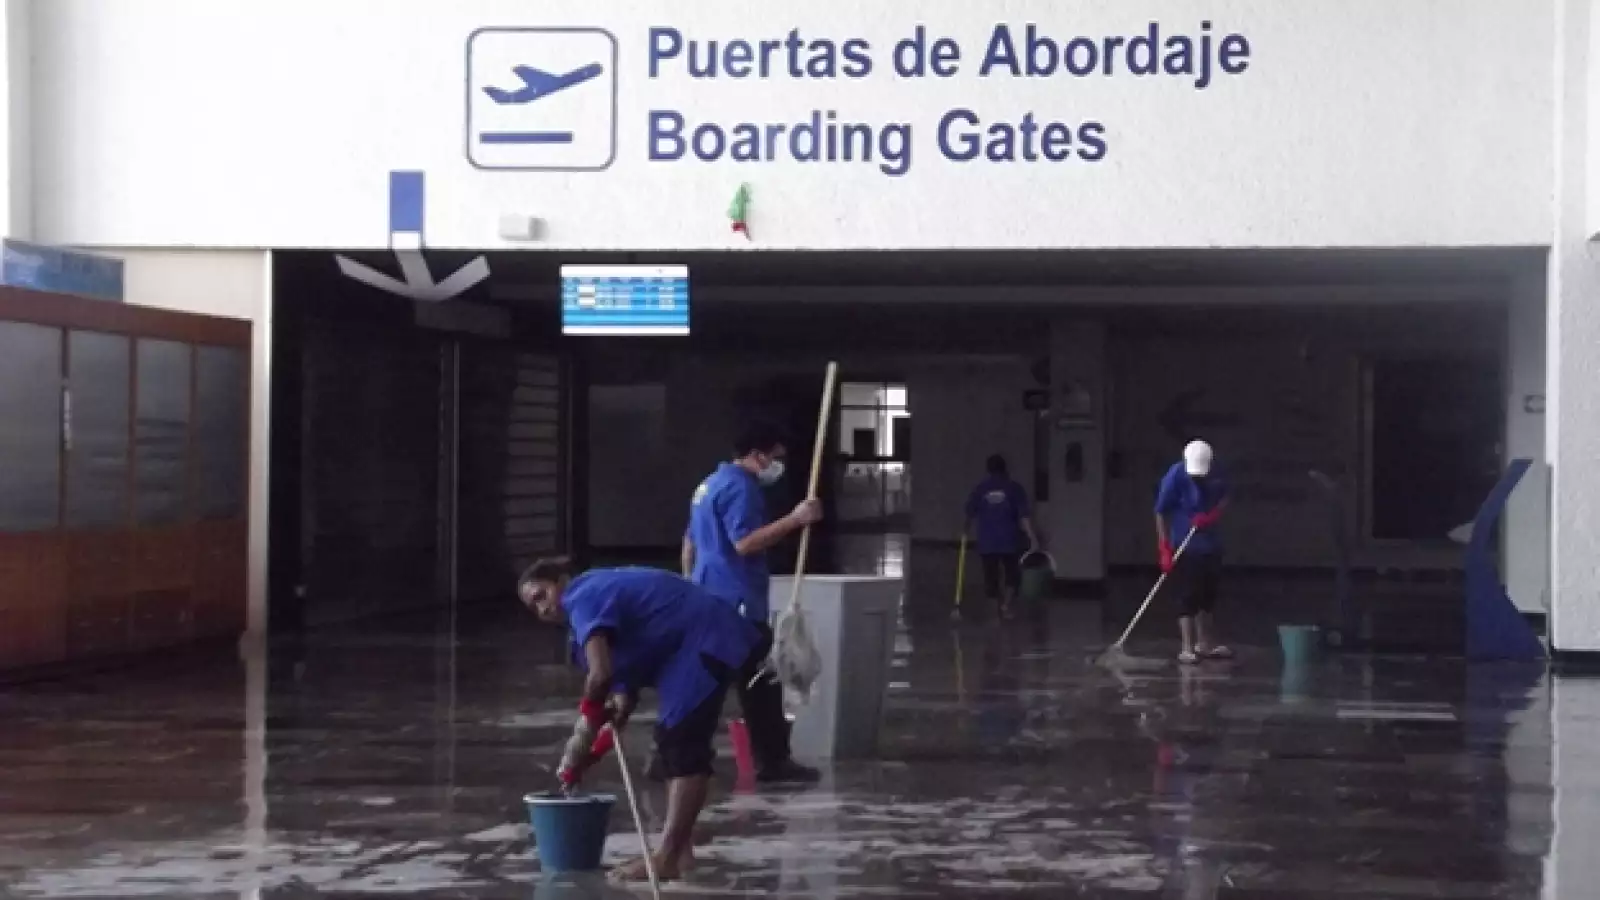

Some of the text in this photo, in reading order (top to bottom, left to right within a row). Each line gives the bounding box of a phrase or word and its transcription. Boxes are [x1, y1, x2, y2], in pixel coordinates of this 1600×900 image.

[648, 22, 1250, 89] Puertas de Abordaje
[648, 109, 1107, 176] Boarding Gates
